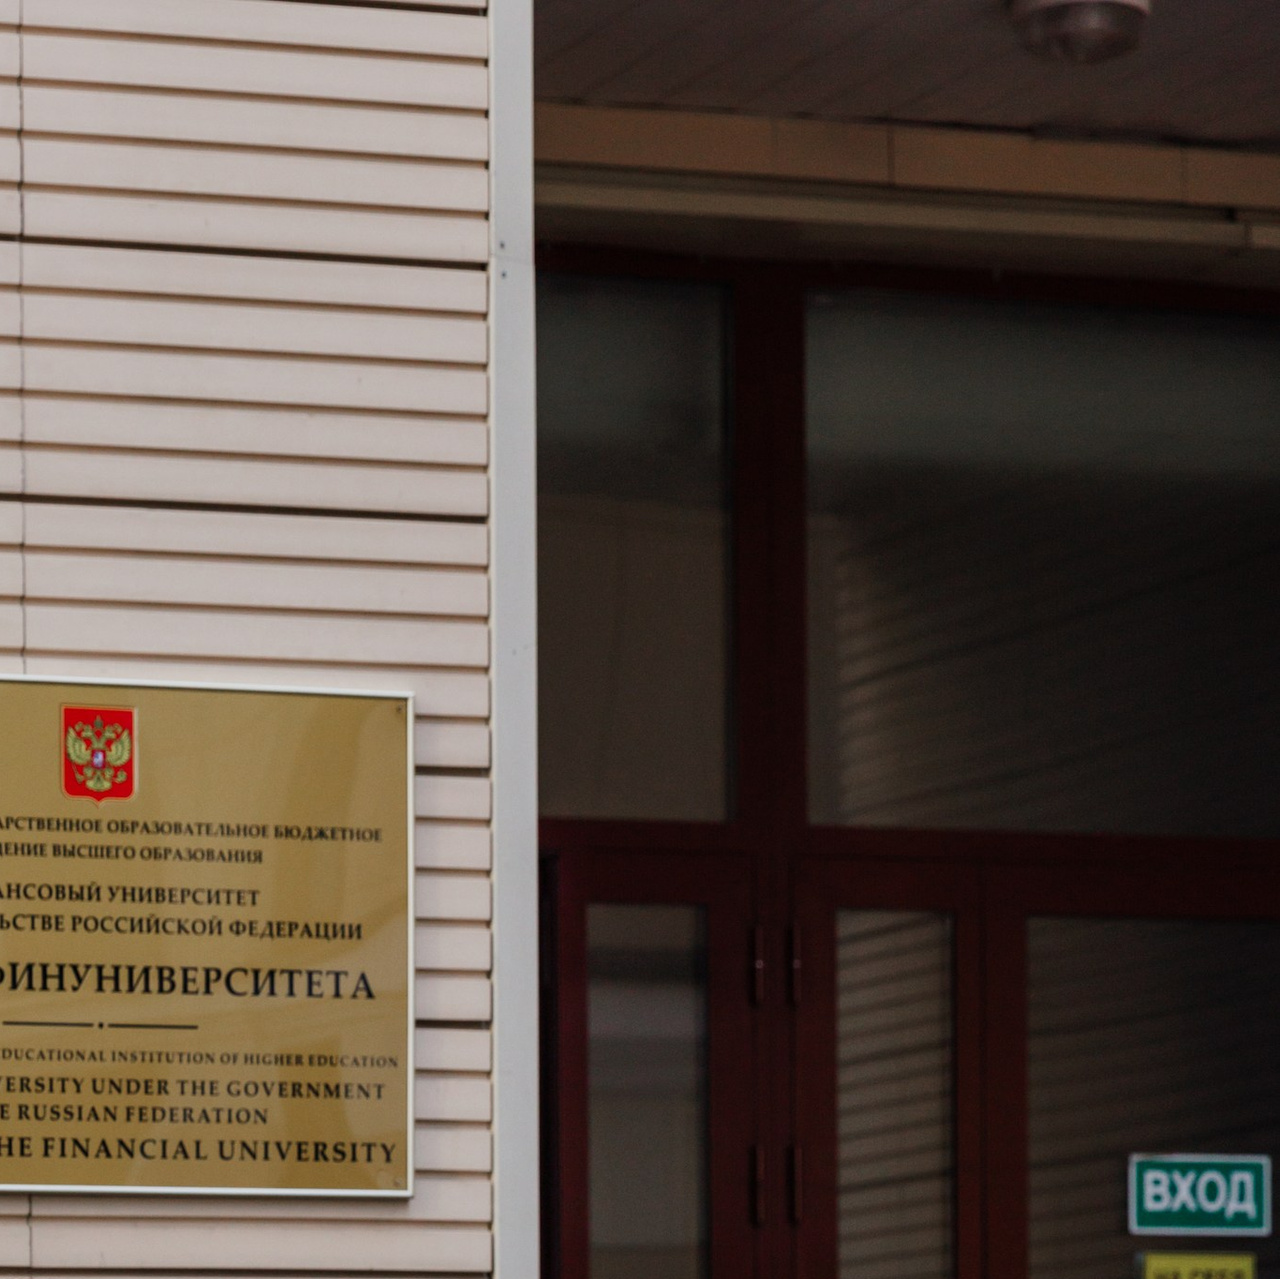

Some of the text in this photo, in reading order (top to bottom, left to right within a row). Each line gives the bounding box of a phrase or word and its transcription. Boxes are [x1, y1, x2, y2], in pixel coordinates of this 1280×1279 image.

[106, 819, 270, 839] ОБРАЗОВАТЕЛЬНОЕ
[273, 825, 383, 843] БЮДЖЕТНОЕ
[52, 844, 136, 860] ВЫСШЕГО
[140, 846, 264, 864] ОБРАЗОВАНИЯ
[107, 886, 261, 907] УНИВЕРСИТЕТ
[71, 914, 223, 937] РОССИЙСКОЙ
[228, 919, 363, 941] ФЕДЕРАЦИИ
[111, 1051, 215, 1065] INSTITUTION
[219, 1052, 240, 1065] OF
[243, 1053, 304, 1066] HIGHER
[308, 1054, 399, 1068] EDUCATION
[91, 1078, 170, 1096] UNDER
[176, 1080, 219, 1097] THE
[226, 1080, 387, 1100] GOVERNMENT
[17, 1105, 118, 1122] RUSSIAN
[124, 1106, 269, 1124] FEDERATION
[41, 1137, 208, 1160] FINANCIAL
[217, 1141, 397, 1163] UNIVERSITY
[1143, 1169, 1256, 1219] ВХОД
